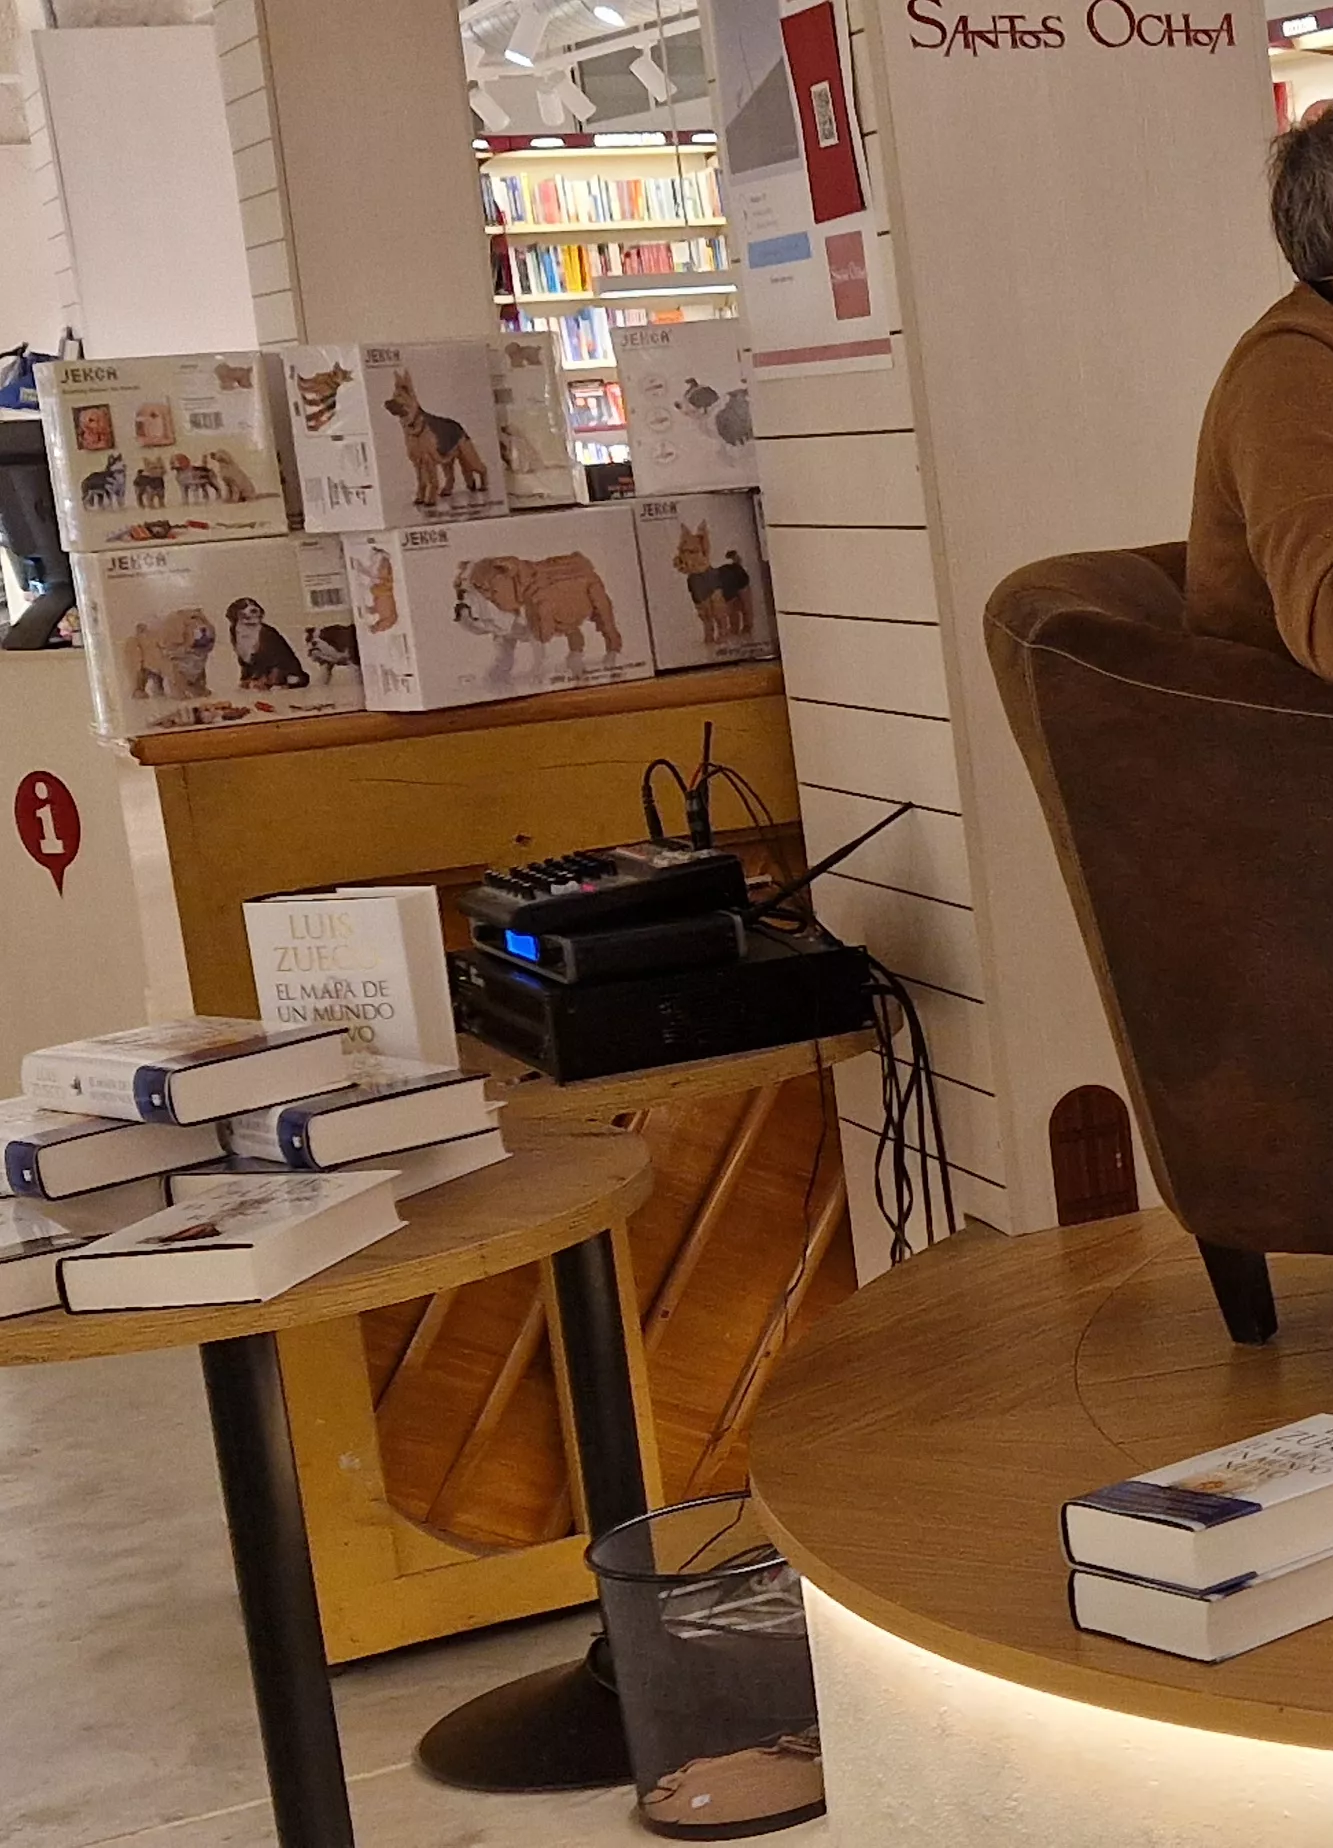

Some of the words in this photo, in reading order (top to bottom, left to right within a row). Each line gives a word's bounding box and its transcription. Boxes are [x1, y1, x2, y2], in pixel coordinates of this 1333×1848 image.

[60, 366, 119, 384] JEKCA
[289, 913, 354, 940] LUIS
[274, 946, 380, 972] ZUECO
[276, 983, 296, 1001] EL
[301, 981, 358, 1000] MAPA
[362, 980, 390, 998] DE
[278, 1005, 307, 1023] UN
[313, 1002, 394, 1022] MUNDO
